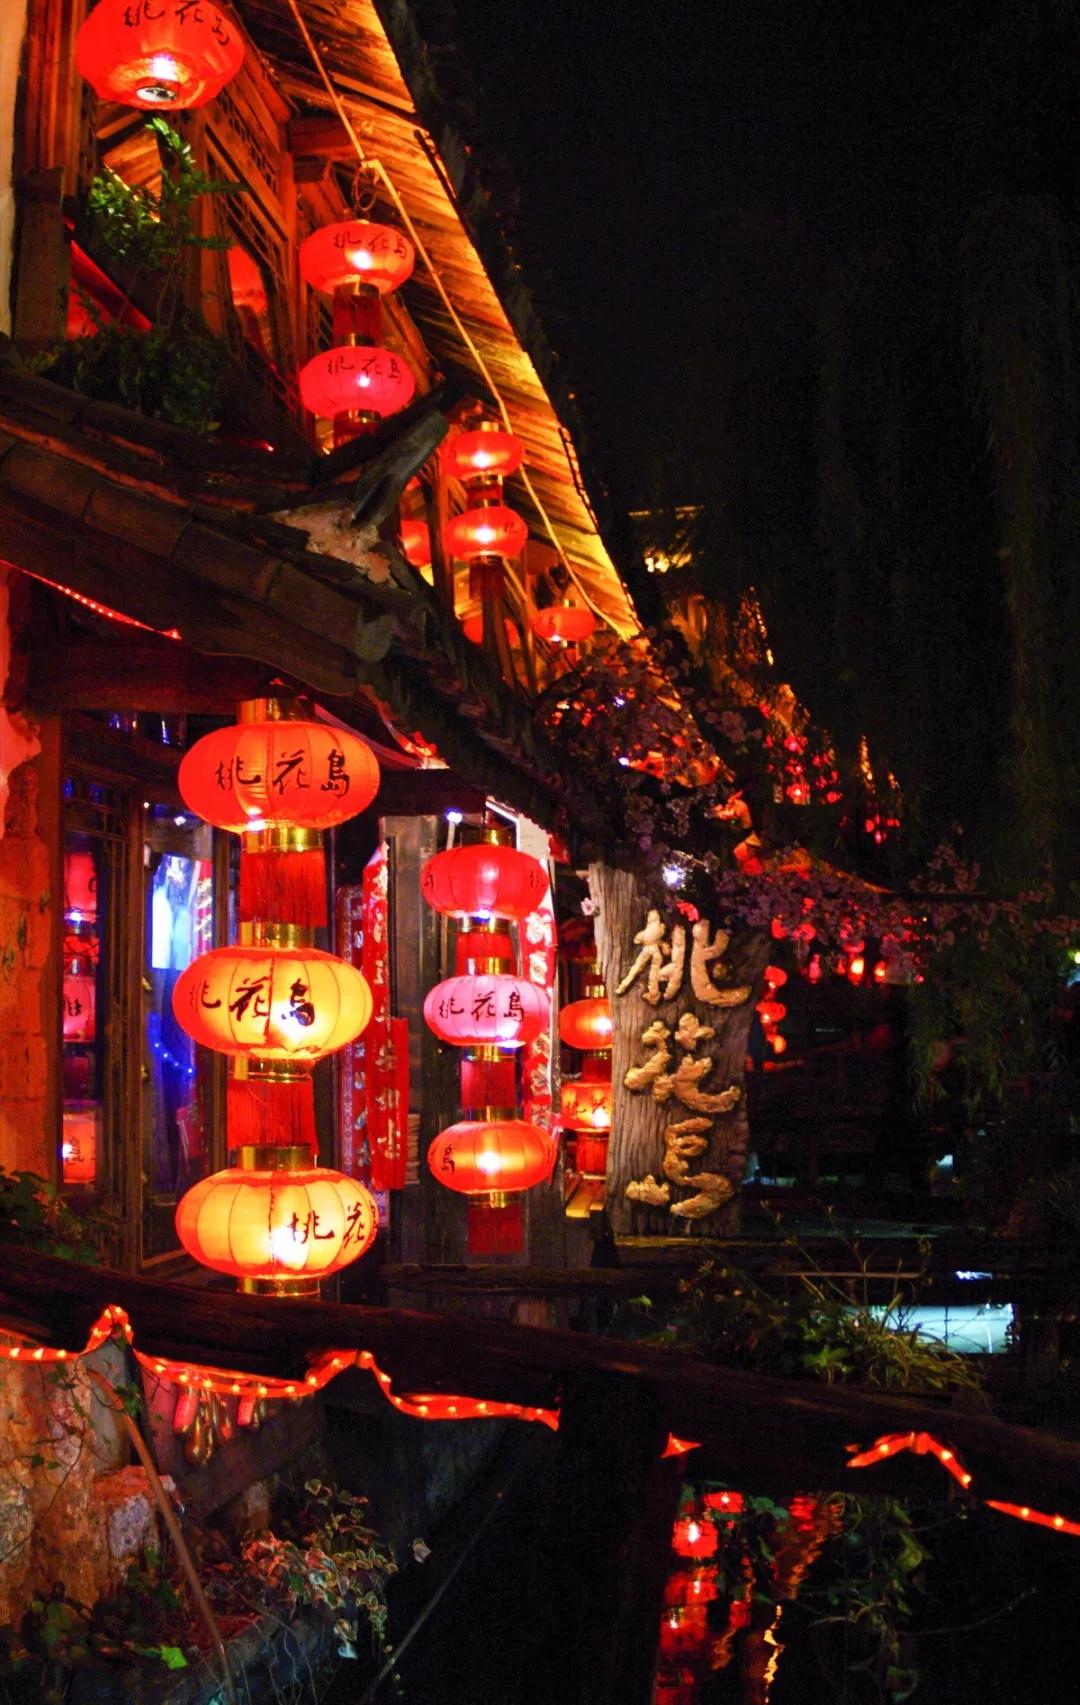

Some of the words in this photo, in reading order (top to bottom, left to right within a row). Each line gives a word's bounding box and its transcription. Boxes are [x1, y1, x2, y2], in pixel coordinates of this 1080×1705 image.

[216, 749, 350, 797] 桃花島
[439, 991, 525, 1022] 桃花島
[287, 1201, 378, 1250] 桃花
